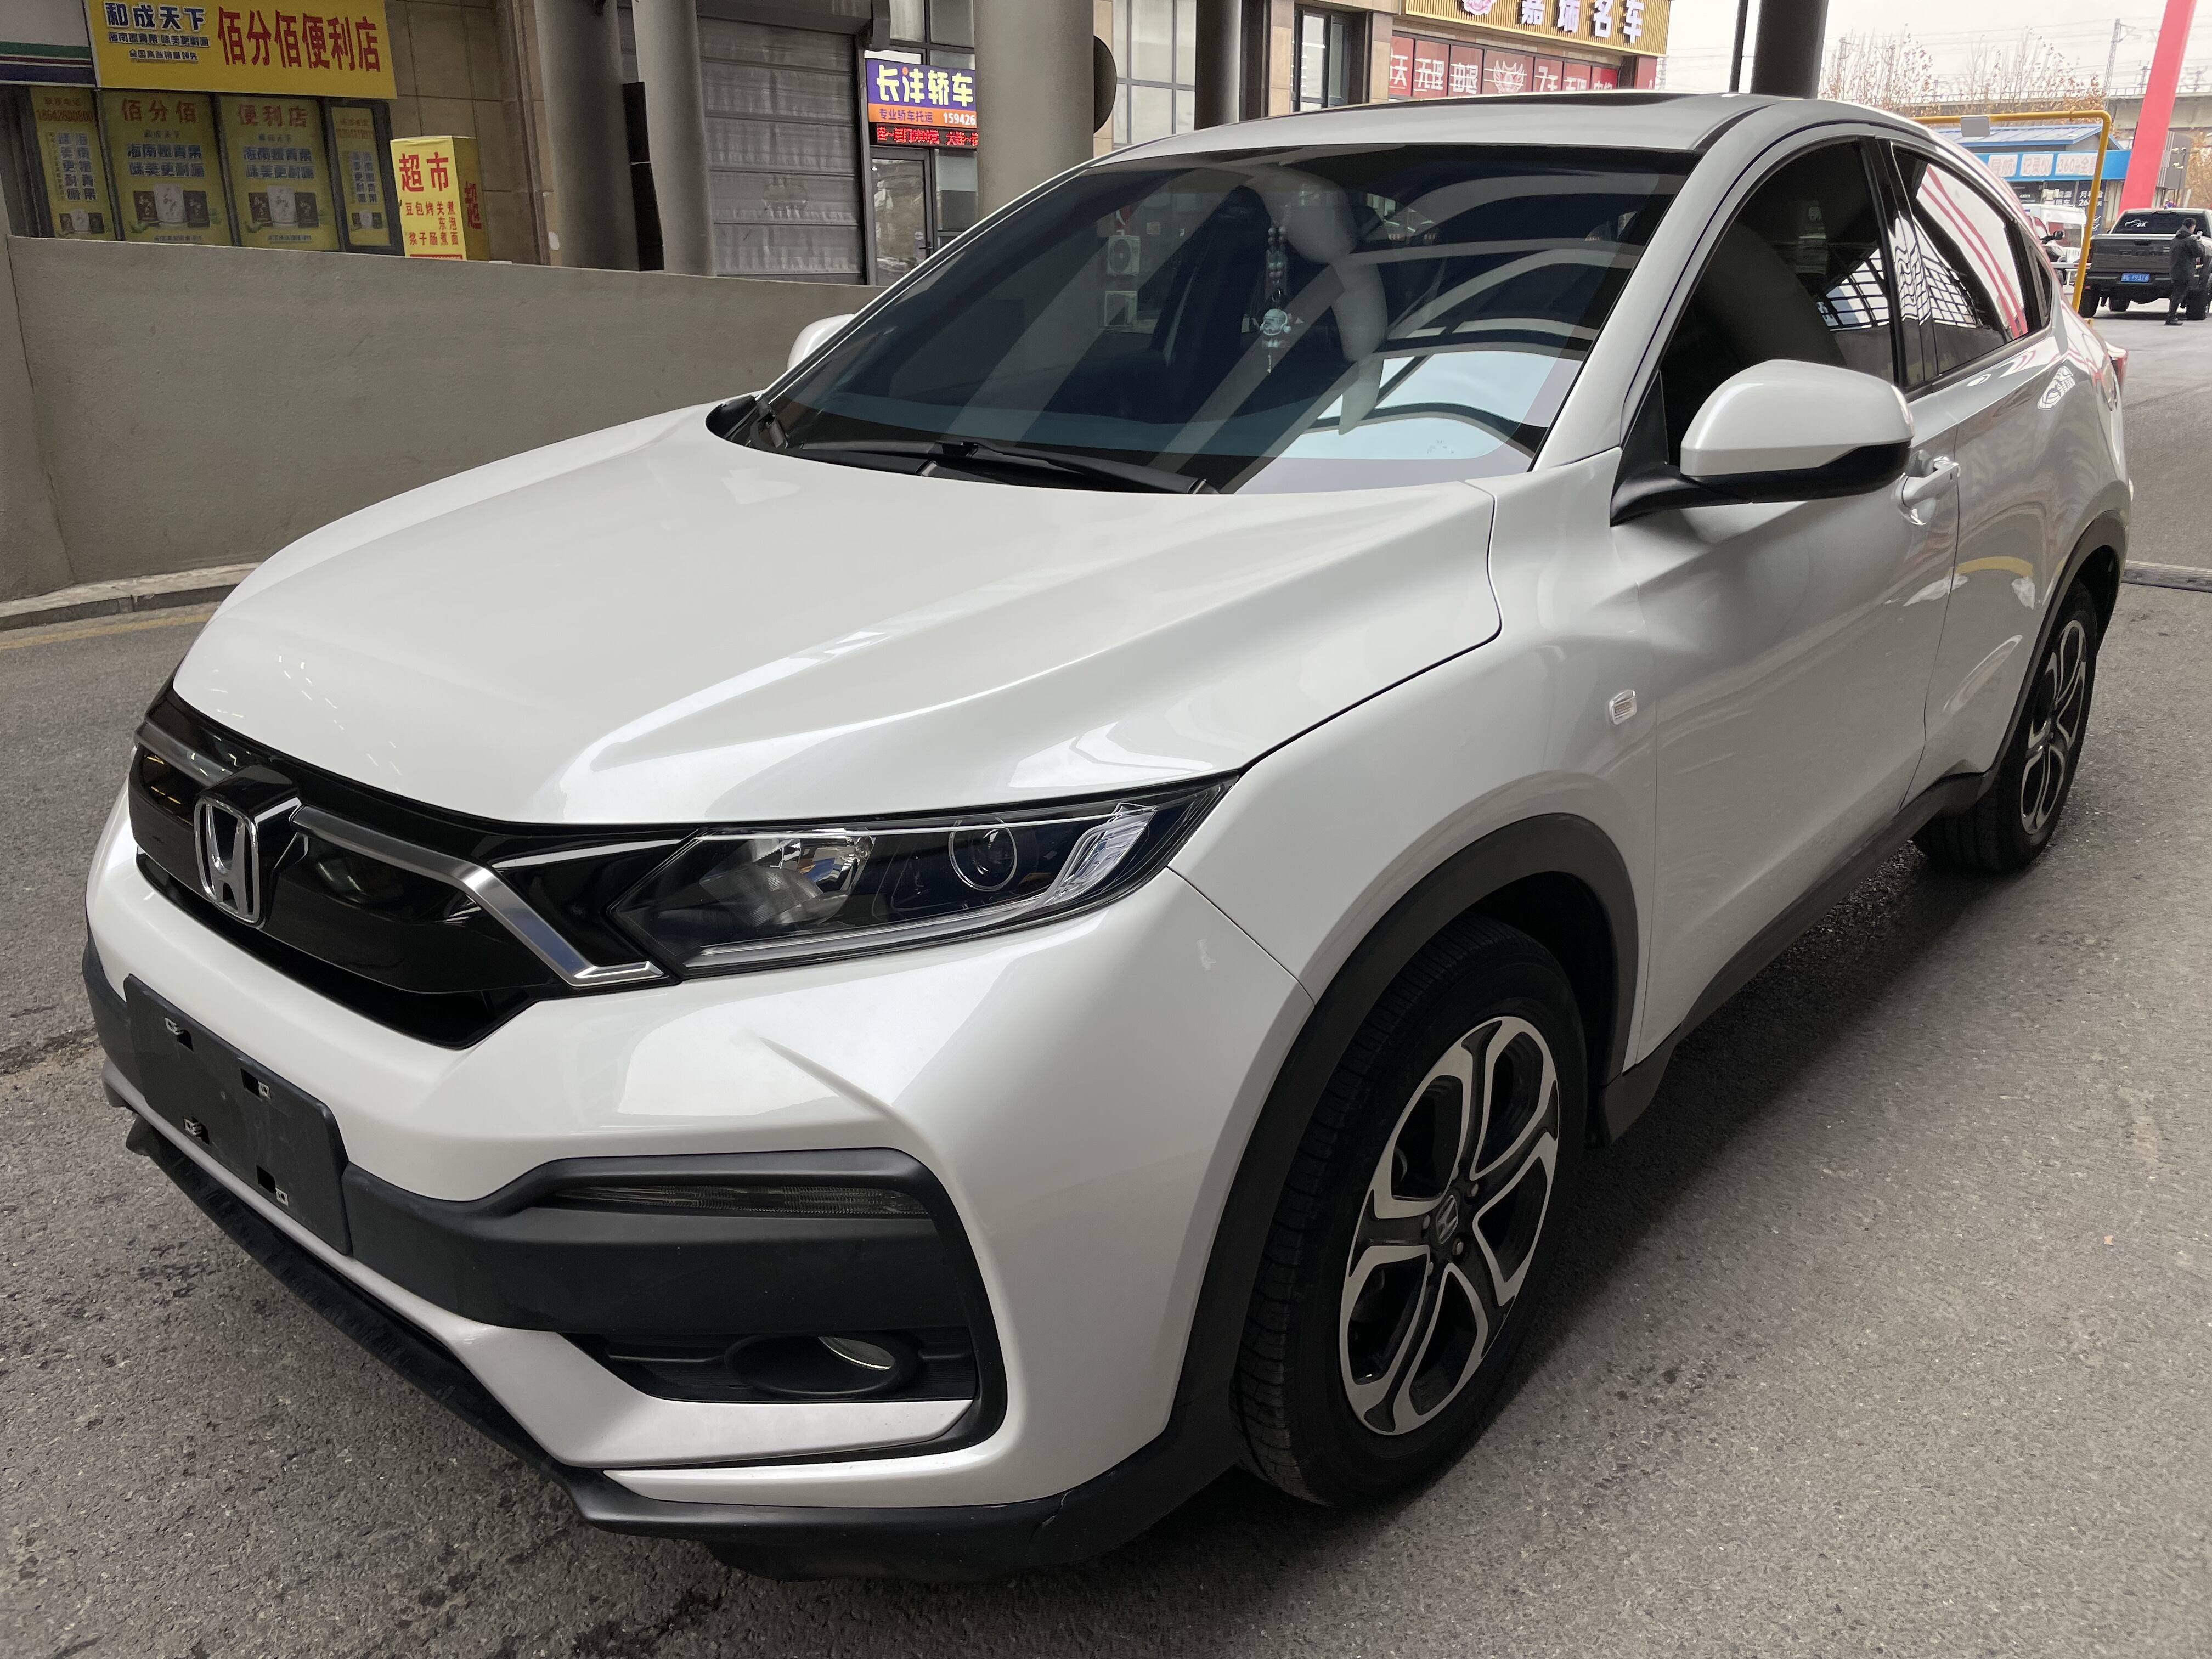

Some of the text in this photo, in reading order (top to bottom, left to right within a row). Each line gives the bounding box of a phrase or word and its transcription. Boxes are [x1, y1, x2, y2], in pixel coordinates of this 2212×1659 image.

[105, 2, 206, 31] 和成天下
[218, 5, 380, 72] 佰分佰便利店
[121, 98, 196, 123] 佰分佰
[237, 104, 308, 127] 便利店
[879, 108, 976, 126] 专业轿车托运 159426
[399, 151, 449, 192] 超市
